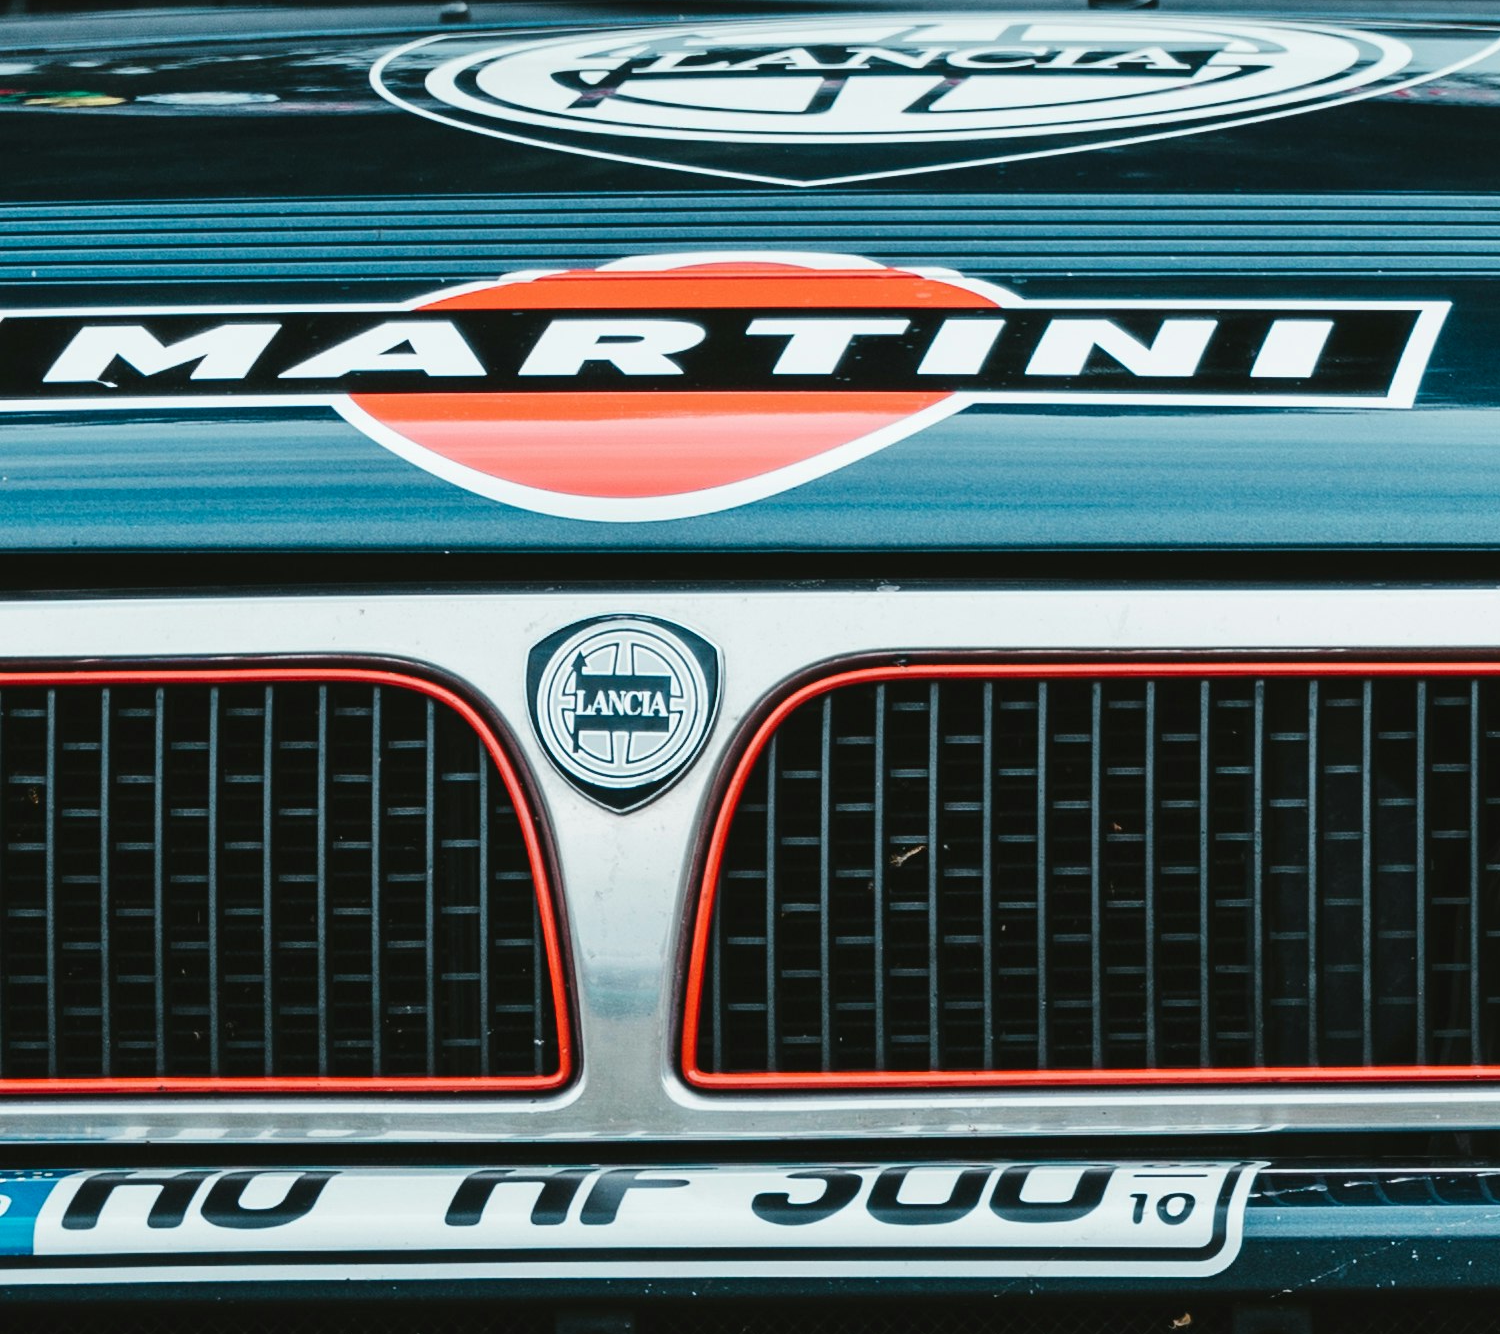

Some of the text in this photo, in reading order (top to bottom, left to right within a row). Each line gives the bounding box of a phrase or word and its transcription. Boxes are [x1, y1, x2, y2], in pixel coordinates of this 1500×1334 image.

[42, 317, 1333, 383] MARTINI
[574, 687, 669, 720] LANCIA
[1129, 1192, 1196, 1226] 10
